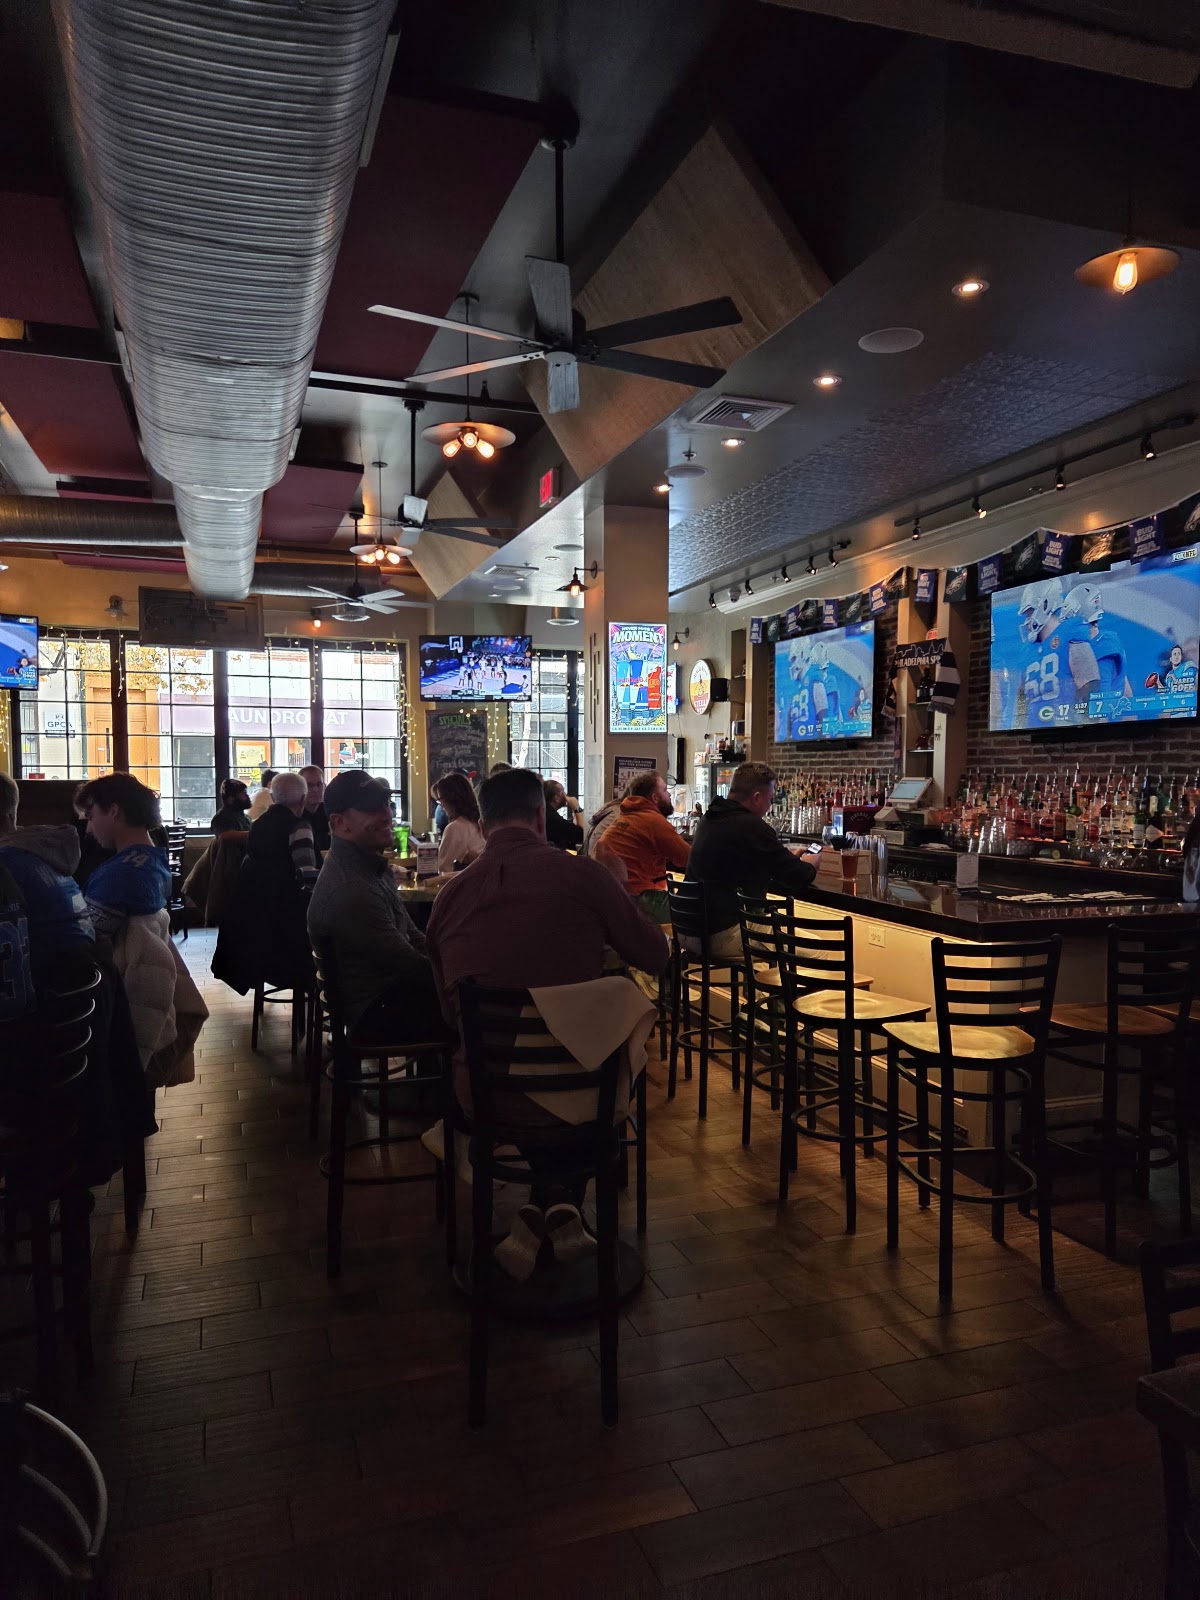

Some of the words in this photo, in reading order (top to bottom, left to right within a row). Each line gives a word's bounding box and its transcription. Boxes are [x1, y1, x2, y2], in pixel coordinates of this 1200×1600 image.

[1134, 530, 1157, 544] LIGHT
[1137, 525, 1154, 537] BUD
[1049, 540, 1063, 549] BUD
[1045, 546, 1064, 556] LIGHT
[981, 567, 997, 580] LIGHT
[983, 563, 995, 573] BUD
[613, 630, 664, 644] MOMENT
[1172, 684, 1195, 692] GOFF
[1058, 704, 1070, 716] 17
[1095, 701, 1103, 713] 7
[228, 708, 349, 725] AUNDROAT
